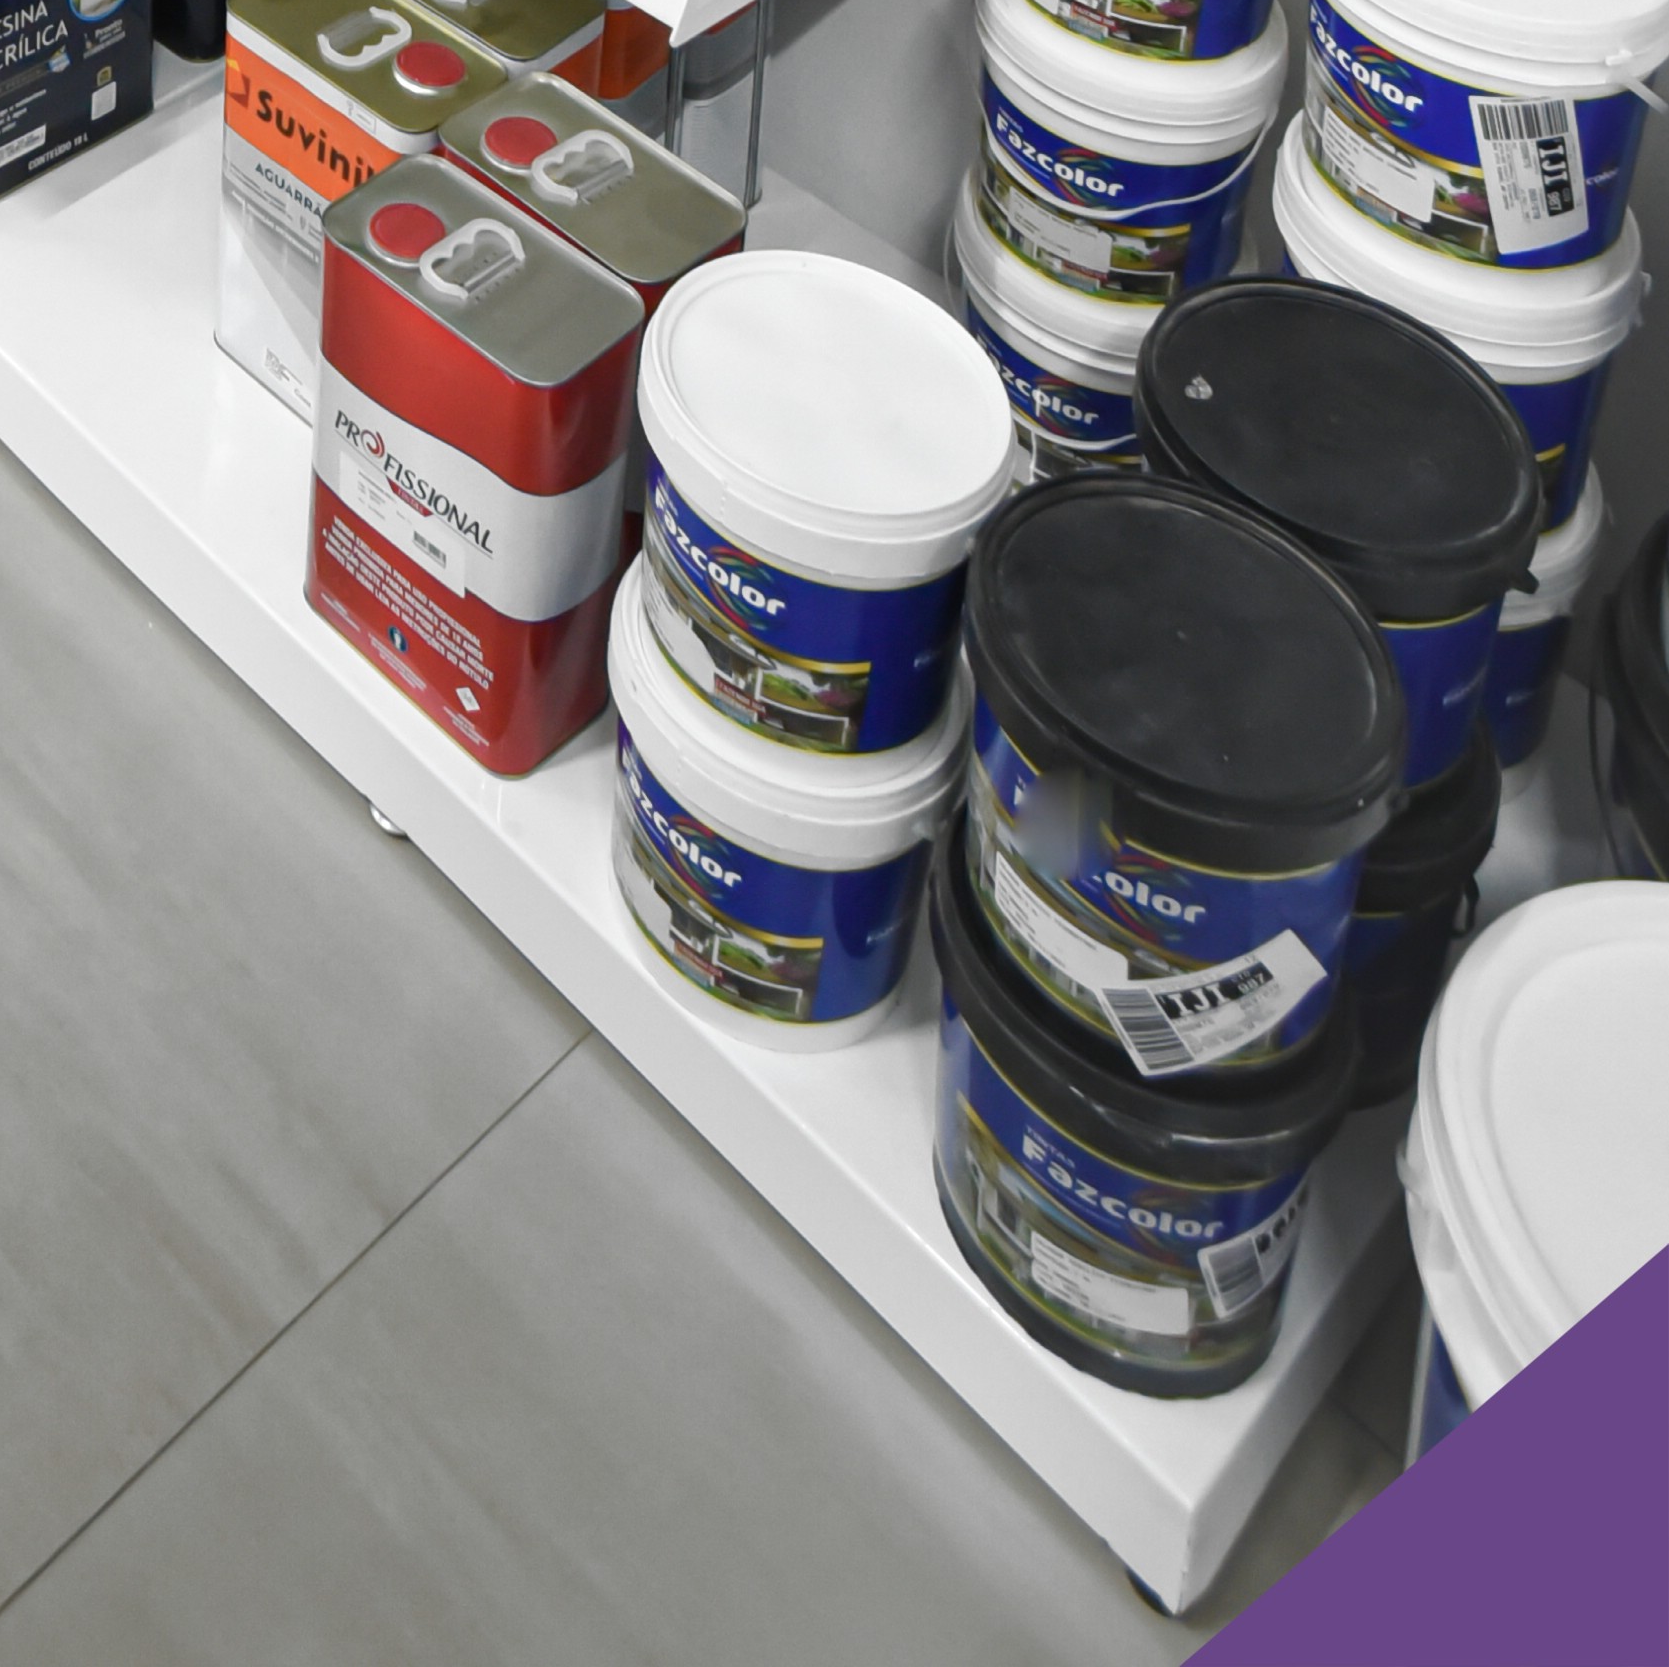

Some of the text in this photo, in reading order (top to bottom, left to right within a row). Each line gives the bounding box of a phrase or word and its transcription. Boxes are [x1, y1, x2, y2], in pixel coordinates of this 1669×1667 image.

[254, 161, 324, 218] AGUARRÁ
[255, 89, 374, 188] Suvini
[996, 112, 1125, 197] Fazcolor
[333, 409, 494, 556] PROFISSIONAL
[654, 485, 786, 616] Fazcolor
[621, 746, 743, 889] Fazcolor
[1022, 1134, 1224, 1240] Fazcolor
